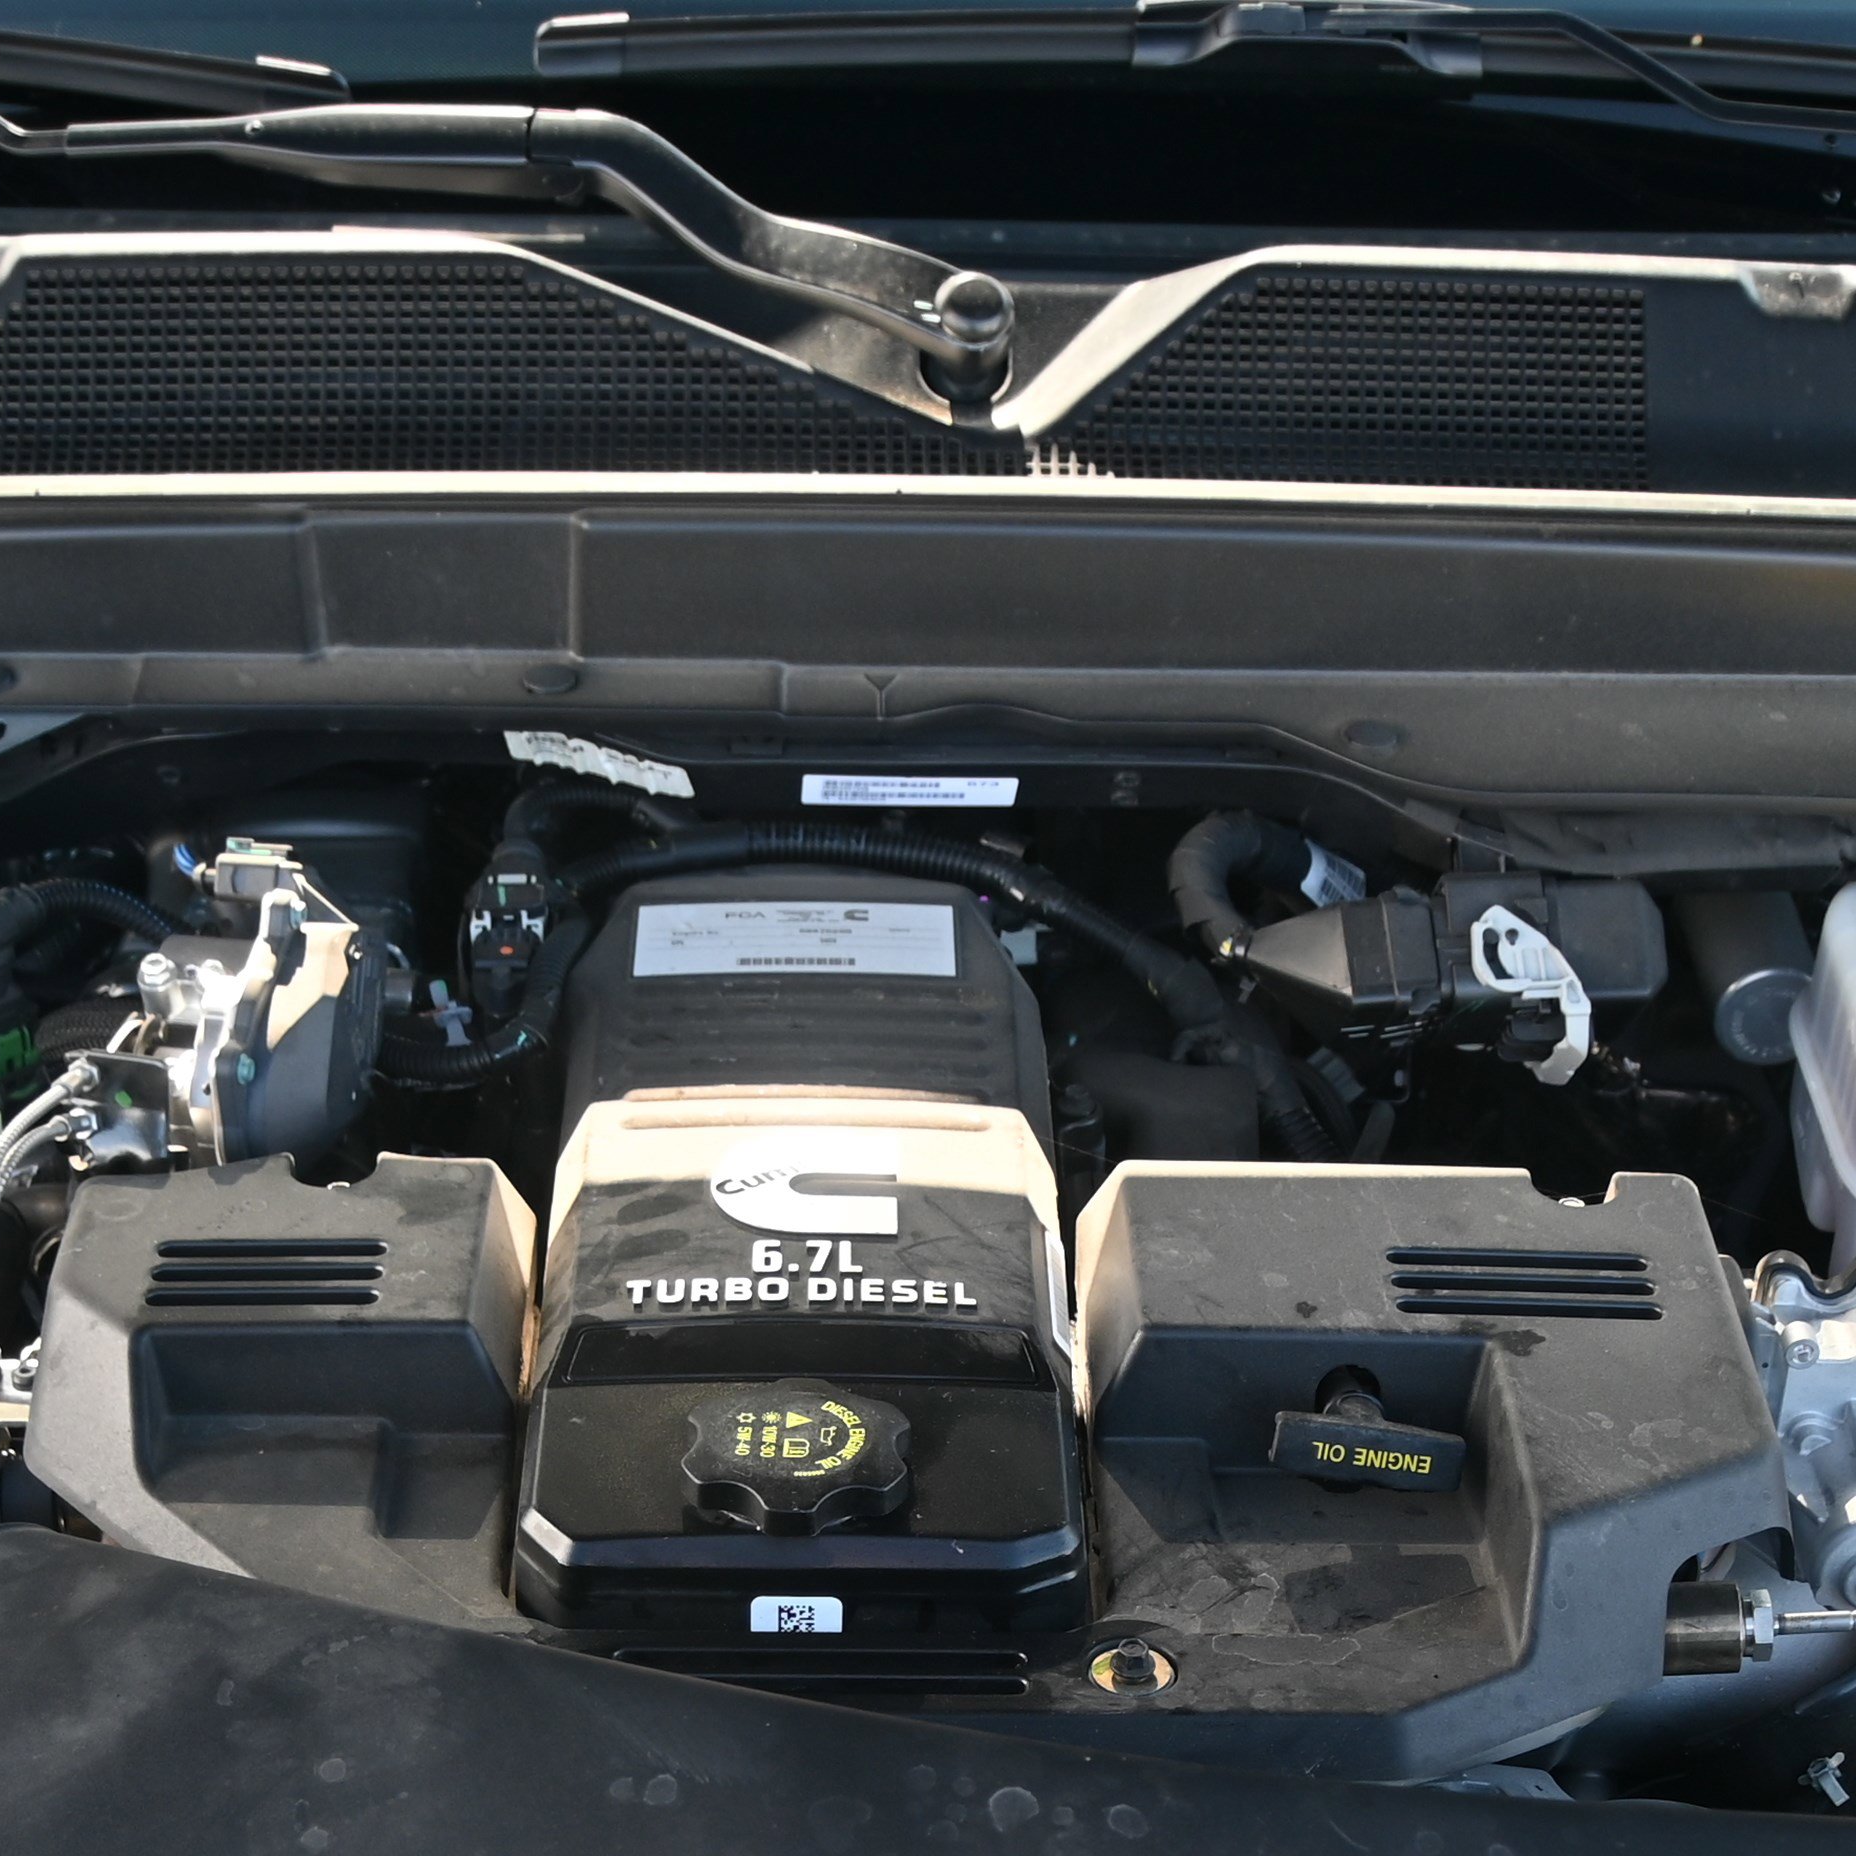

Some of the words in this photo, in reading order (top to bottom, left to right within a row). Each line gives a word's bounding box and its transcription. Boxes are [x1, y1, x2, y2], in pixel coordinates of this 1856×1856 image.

[751, 1239, 863, 1273] 6.7L
[626, 1277, 790, 1305] TURBO
[807, 1277, 977, 1306] DIESEL
[821, 1401, 862, 1428] DIESEL
[735, 1426, 753, 1455] 5W-40
[760, 1425, 778, 1457] 10W-30
[836, 1428, 865, 1461] ENGINE
[1312, 1441, 1345, 1463] OIL
[815, 1456, 842, 1469] OIL
[1352, 1447, 1432, 1474] ENGINE
